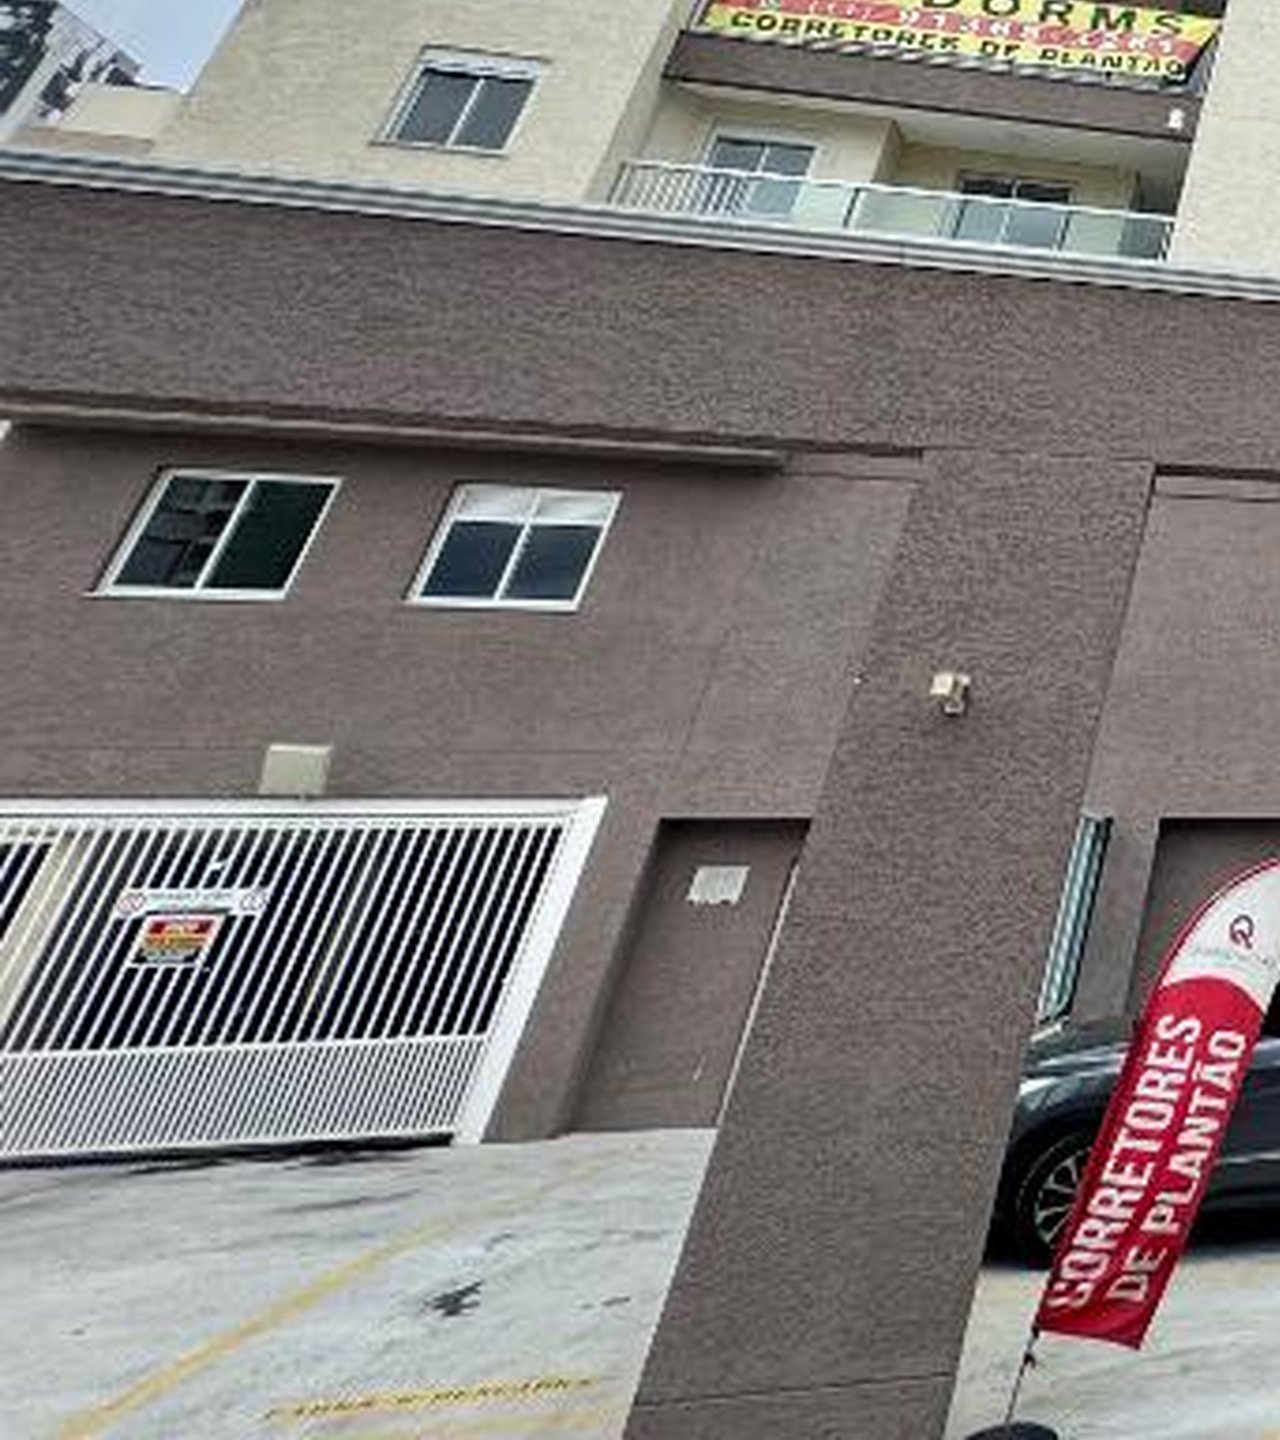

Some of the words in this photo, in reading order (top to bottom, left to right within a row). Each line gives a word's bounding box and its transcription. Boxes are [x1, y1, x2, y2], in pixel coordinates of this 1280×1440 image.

[1046, 1011, 1202, 1310] CORRETORES
[1106, 1246, 1166, 1304] DE
[1153, 1027, 1248, 1234] PLANTÃO
